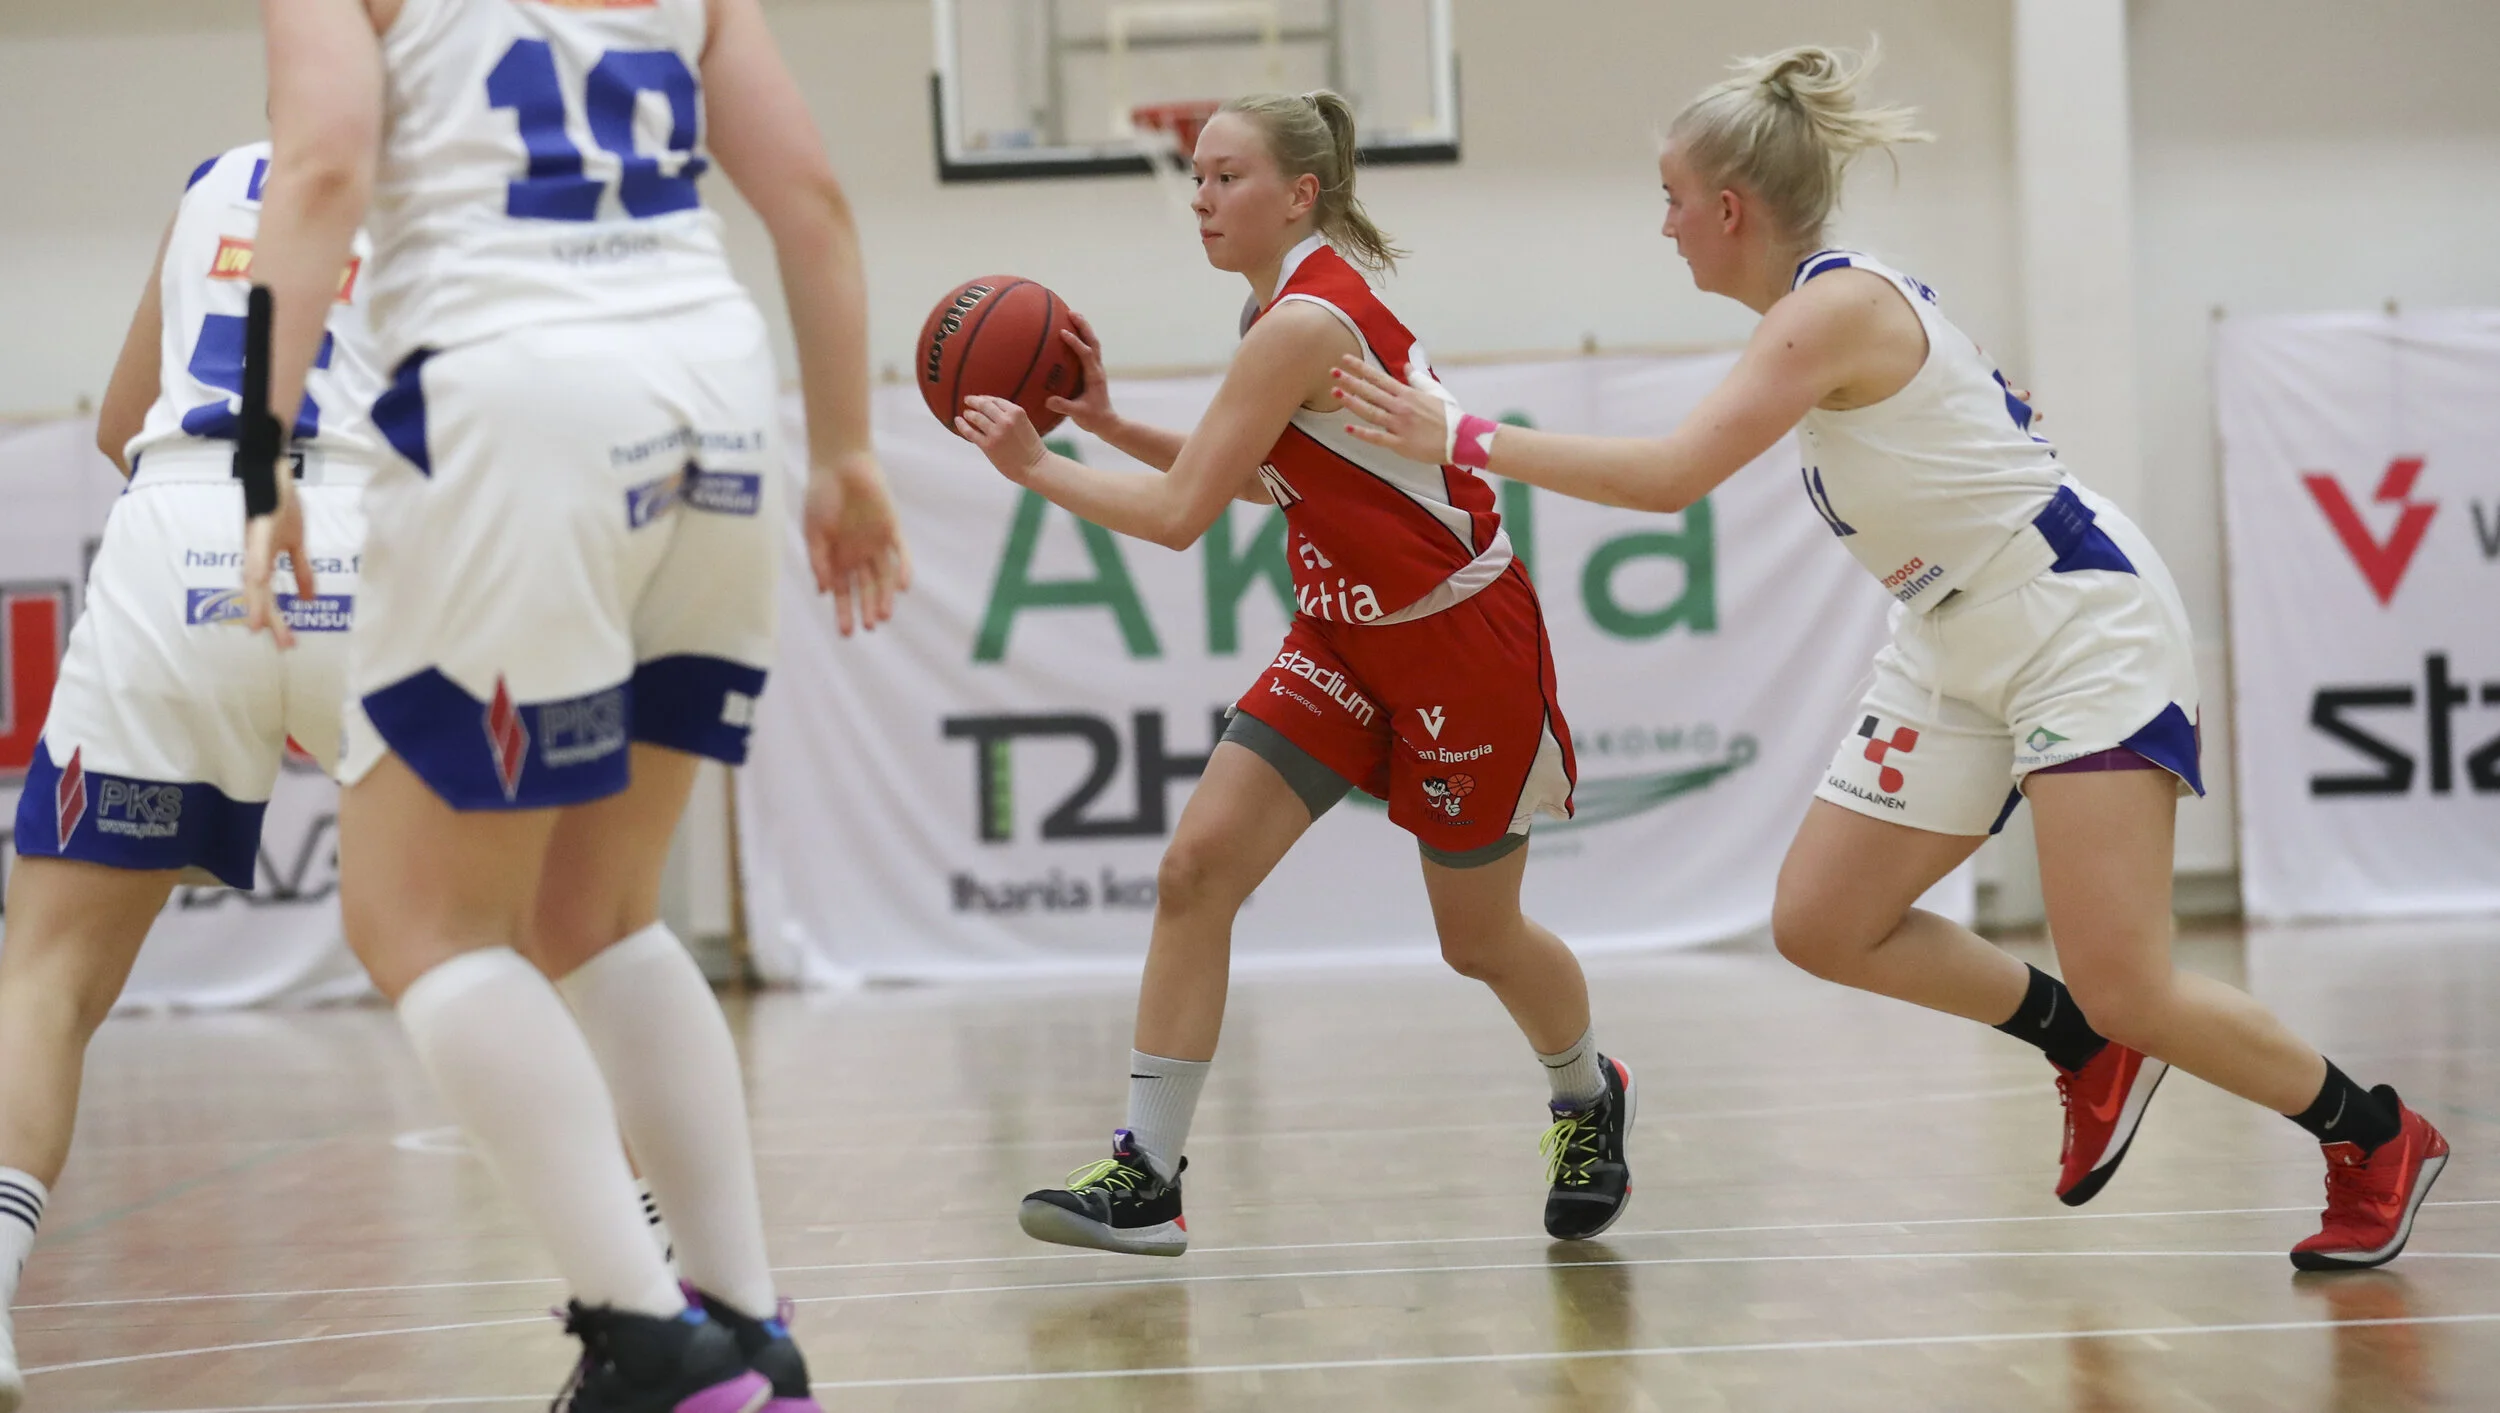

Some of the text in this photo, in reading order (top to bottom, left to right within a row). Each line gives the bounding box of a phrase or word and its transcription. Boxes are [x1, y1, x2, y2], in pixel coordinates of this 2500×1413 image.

[486, 38, 705, 221] 10
[928, 285, 995, 383] Wilson
[1294, 578, 1384, 625] ktia
[540, 688, 625, 748] PKS
[1272, 650, 1375, 727] stadium
[1438, 744, 1493, 763] Energia
[98, 780, 183, 822] PKS
